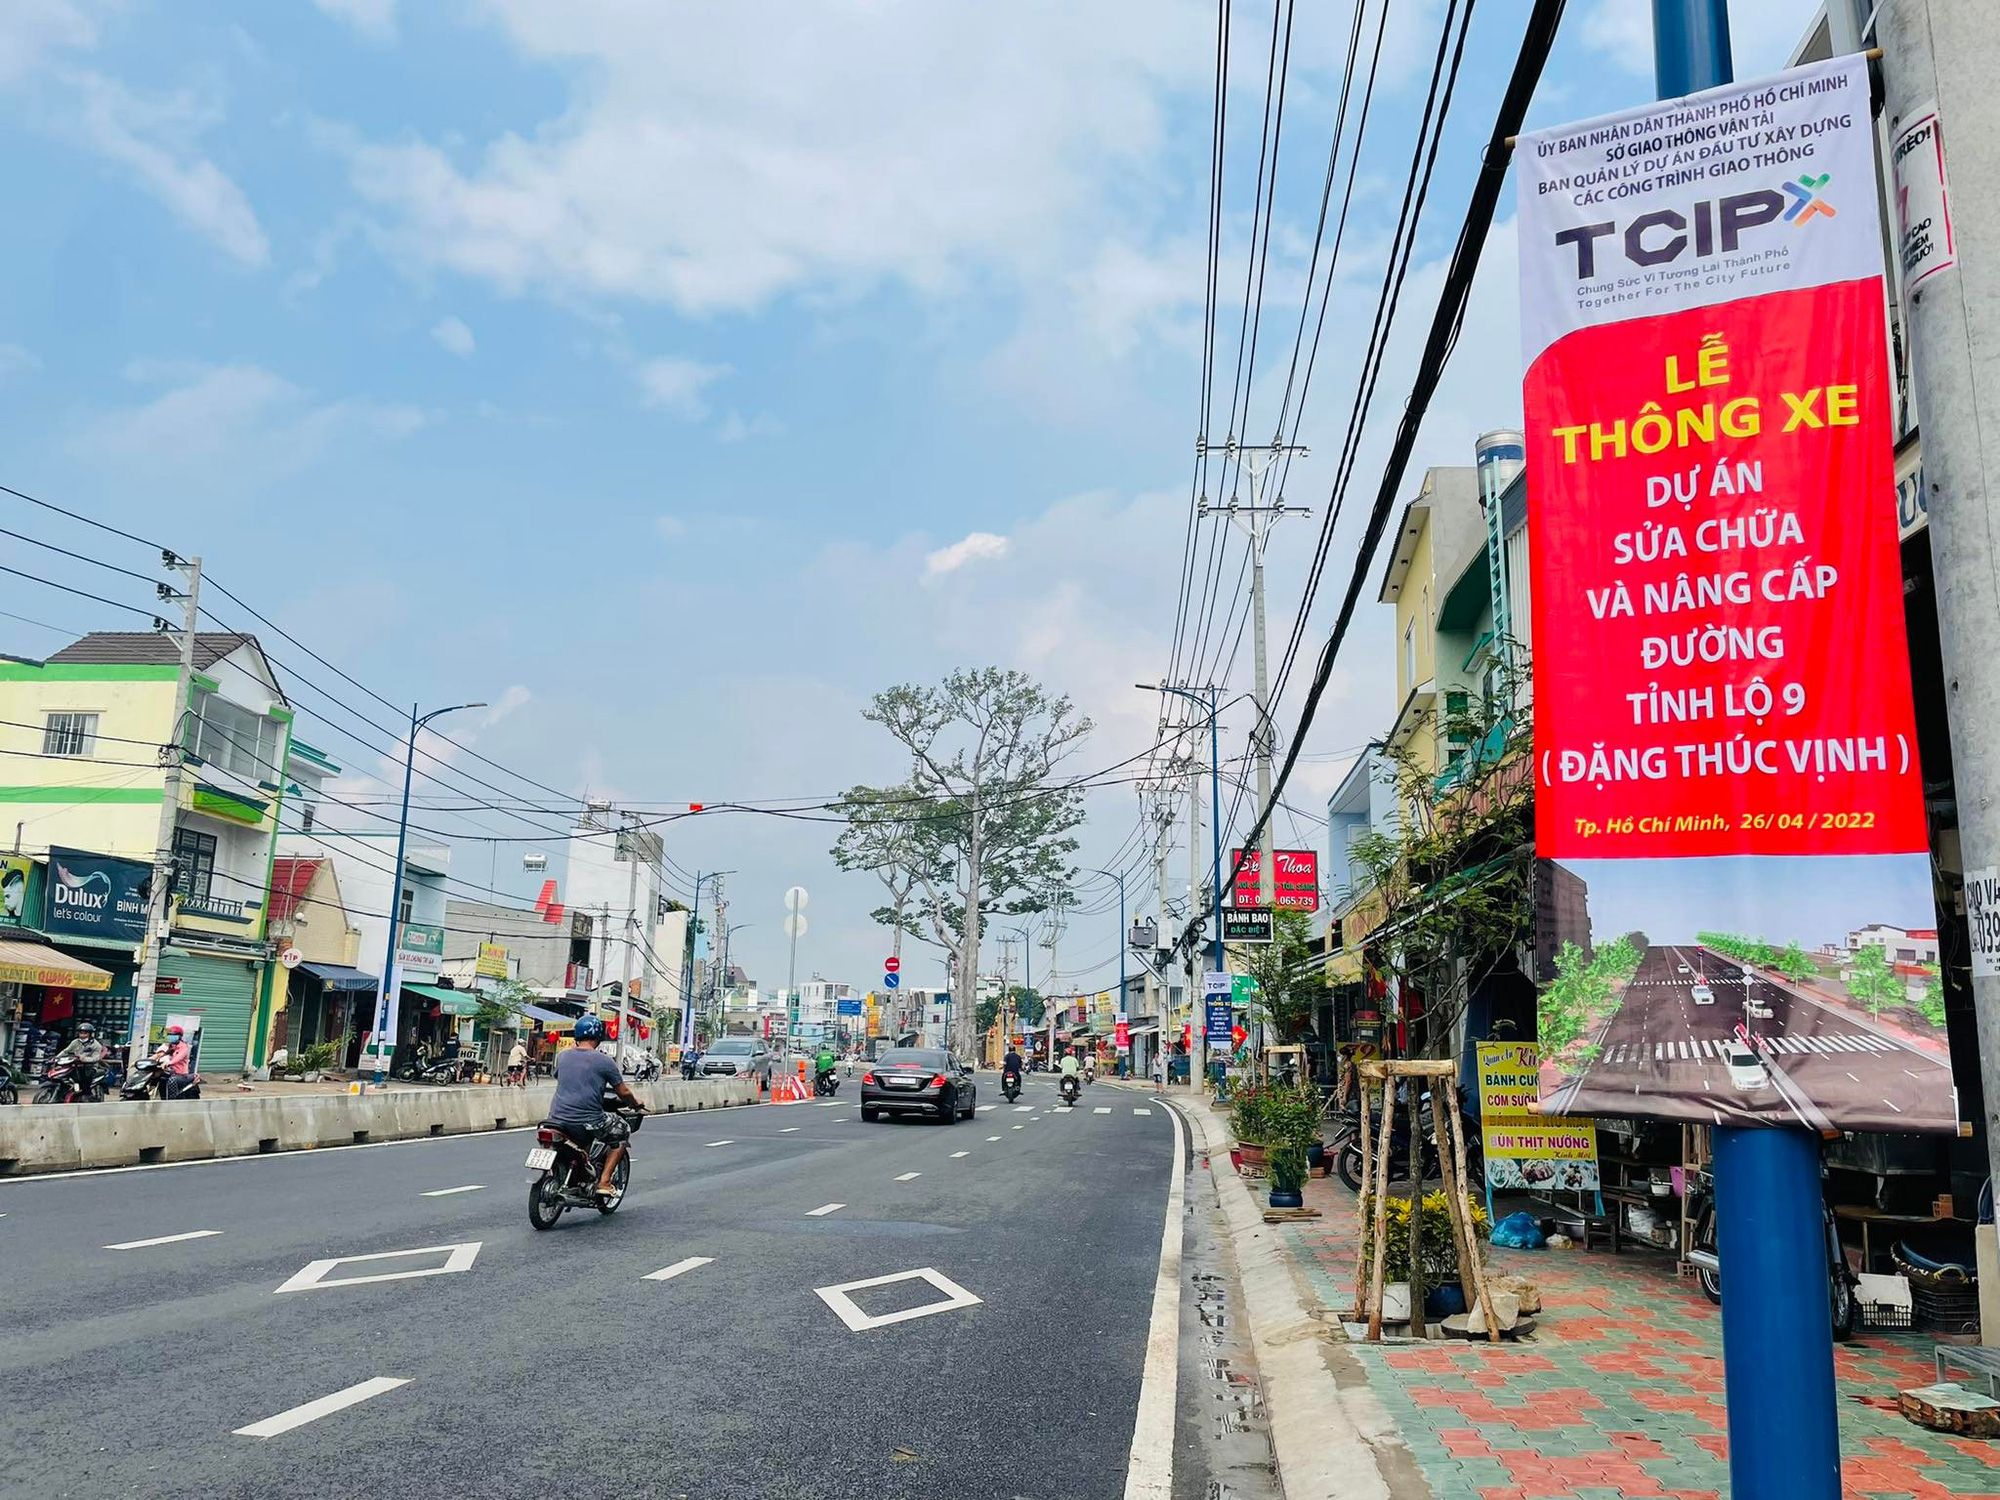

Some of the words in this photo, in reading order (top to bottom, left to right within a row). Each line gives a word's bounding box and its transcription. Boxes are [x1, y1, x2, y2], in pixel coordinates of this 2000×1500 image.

[1559, 133, 1587, 155] BAN
[1590, 126, 1630, 148] NHÂN
[1633, 117, 1664, 138] DÂN
[1666, 105, 1717, 130] THÀNH
[1720, 91, 1751, 117] PHỐ
[1779, 82, 1805, 102] CHÍ
[1808, 74, 1848, 97] MINH
[1606, 142, 1625, 163] SỞ
[1627, 136, 1663, 158] GIAO
[1665, 124, 1717, 150] THÔNG
[1719, 118, 1750, 141] VẬN
[1751, 111, 1775, 131] TẢI
[1538, 176, 1570, 195] BAN
[1573, 164, 1619, 190] QUẢN
[1622, 160, 1640, 179] LÝ
[1643, 153, 1668, 174] DỰ
[1672, 146, 1695, 166] ÁN
[1737, 132, 1762, 152] TƯ
[1764, 125, 1797, 147] XÂY
[1800, 114, 1852, 141] DỰNG
[1573, 186, 1604, 207] CÁC
[1607, 174, 1654, 201] CÔNG
[1656, 162, 1704, 188] TRÌNH
[1708, 157, 1750, 178] GIAO
[1753, 142, 1815, 169] THÔNG
[1555, 189, 1785, 280] TCIP
[1577, 282, 1615, 297] Chung
[1617, 275, 1641, 289] Sức
[1659, 267, 1700, 282] Tương
[1702, 262, 1720, 274] Lai
[1724, 254, 1762, 269] Thành
[1765, 245, 1790, 260] Phố
[1577, 290, 1641, 311] Together
[1645, 285, 1670, 297] For
[1674, 279, 1701, 292] The
[1705, 272, 1736, 287] City
[1740, 262, 1791, 280] Future
[1664, 331, 1731, 396] LỄ
[1552, 397, 1762, 466] THÔNG
[1780, 383, 1861, 434] XE
[1645, 467, 1702, 511] DỰ
[1709, 460, 1764, 498] ÁN
[1613, 519, 1687, 566] SỬA
[1695, 507, 1805, 554] CHỮA
[1586, 584, 1636, 621] VÀ
[1643, 569, 1752, 617] NÂNG
[1761, 555, 1839, 603] CẤP
[1639, 622, 1785, 672] ĐƯỜNG
[1625, 680, 1715, 726] TỈNH
[1724, 676, 1774, 726] LỘ
[1783, 681, 1806, 717] 9
[1559, 740, 1668, 792] ĐẶNG
[1672, 735, 1778, 778] THÚC
[1783, 735, 1888, 784] VỊNH
[1573, 817, 1602, 838] Tp.
[1606, 815, 1635, 834] Hồ
[1638, 813, 1671, 834] Chí
[1674, 813, 1731, 833] Minh,
[1277, 854, 1312, 874] Thoa
[53, 906, 73, 919] let's
[73, 911, 102, 923] colour
[54, 883, 103, 909] Dulux
[117, 900, 139, 914] BÌNH
[1227, 911, 1250, 923] BÁNH
[1251, 912, 1268, 923] BAO
[1485, 1071, 1516, 1087] BÁNH
[1517, 1136, 1544, 1151] THỊT
[1548, 1133, 1590, 1149] NƯỚNG
